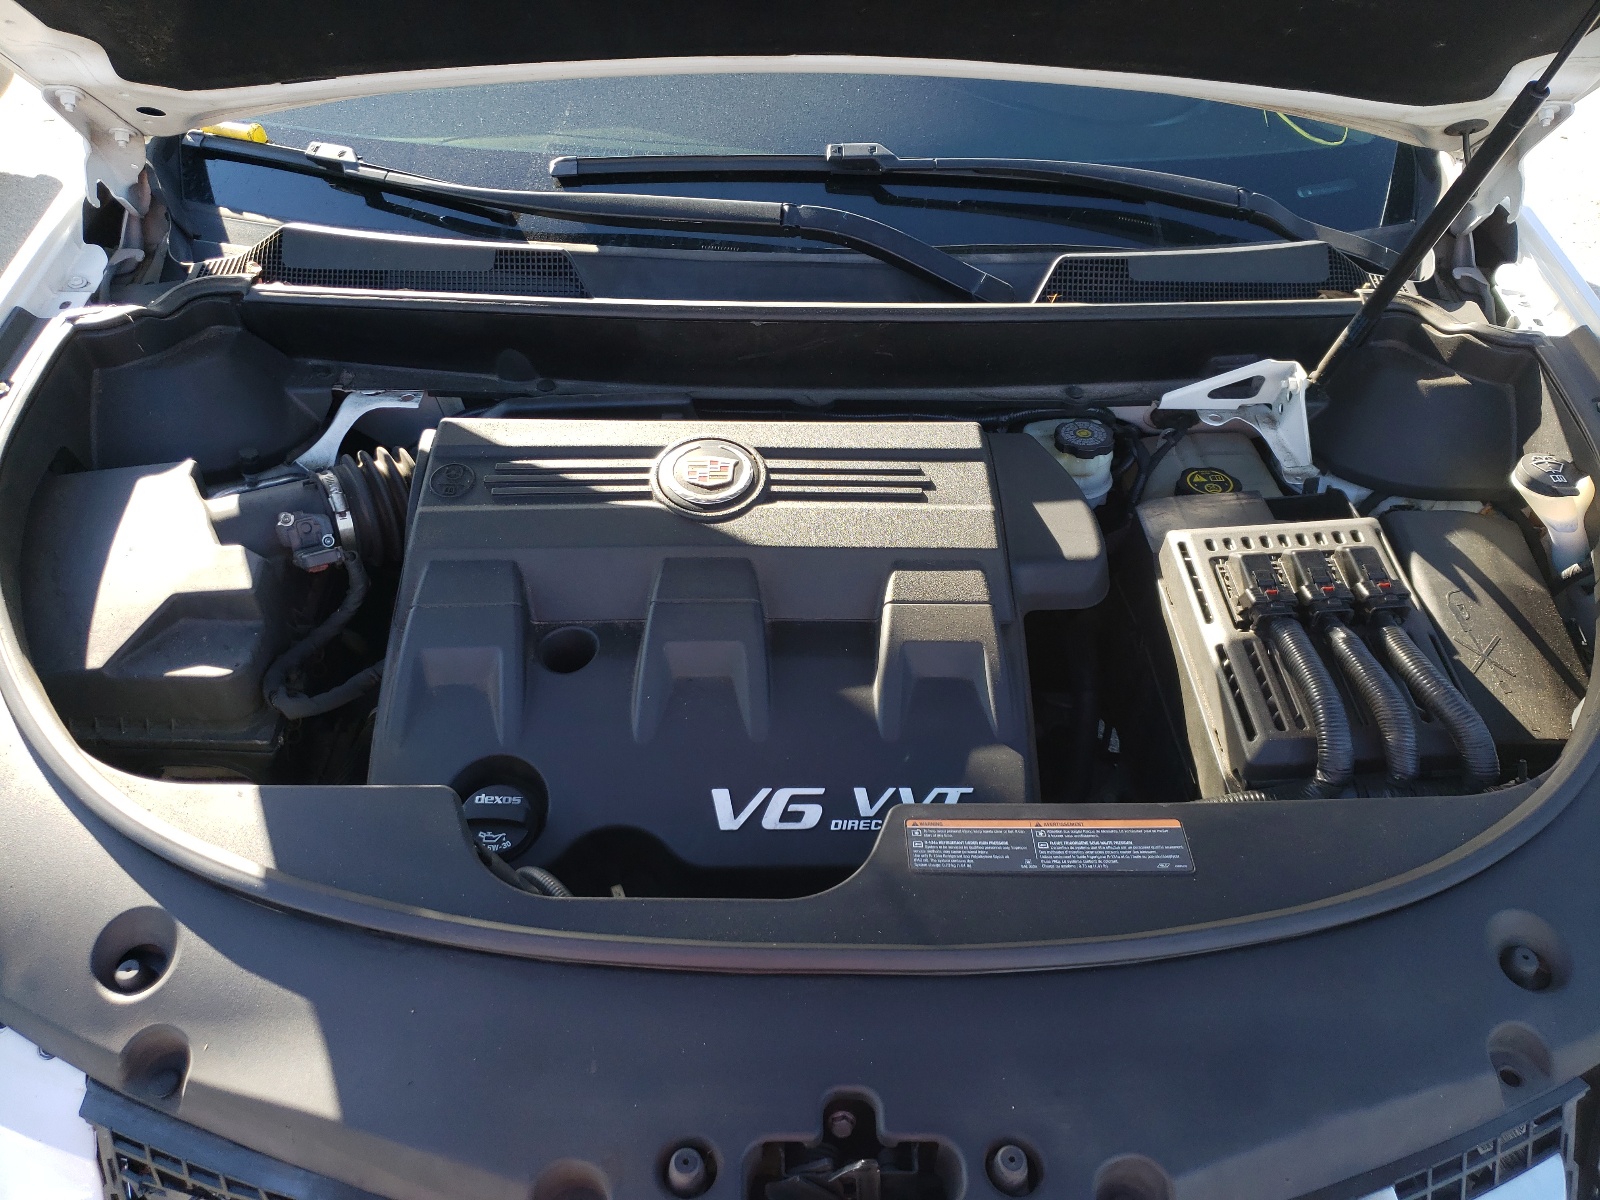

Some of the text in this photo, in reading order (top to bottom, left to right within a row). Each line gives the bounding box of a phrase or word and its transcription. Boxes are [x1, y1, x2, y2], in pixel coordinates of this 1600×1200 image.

[475, 793, 523, 804] dexos
[711, 787, 974, 830] V6 VVT
[830, 819, 883, 831] DIREC
